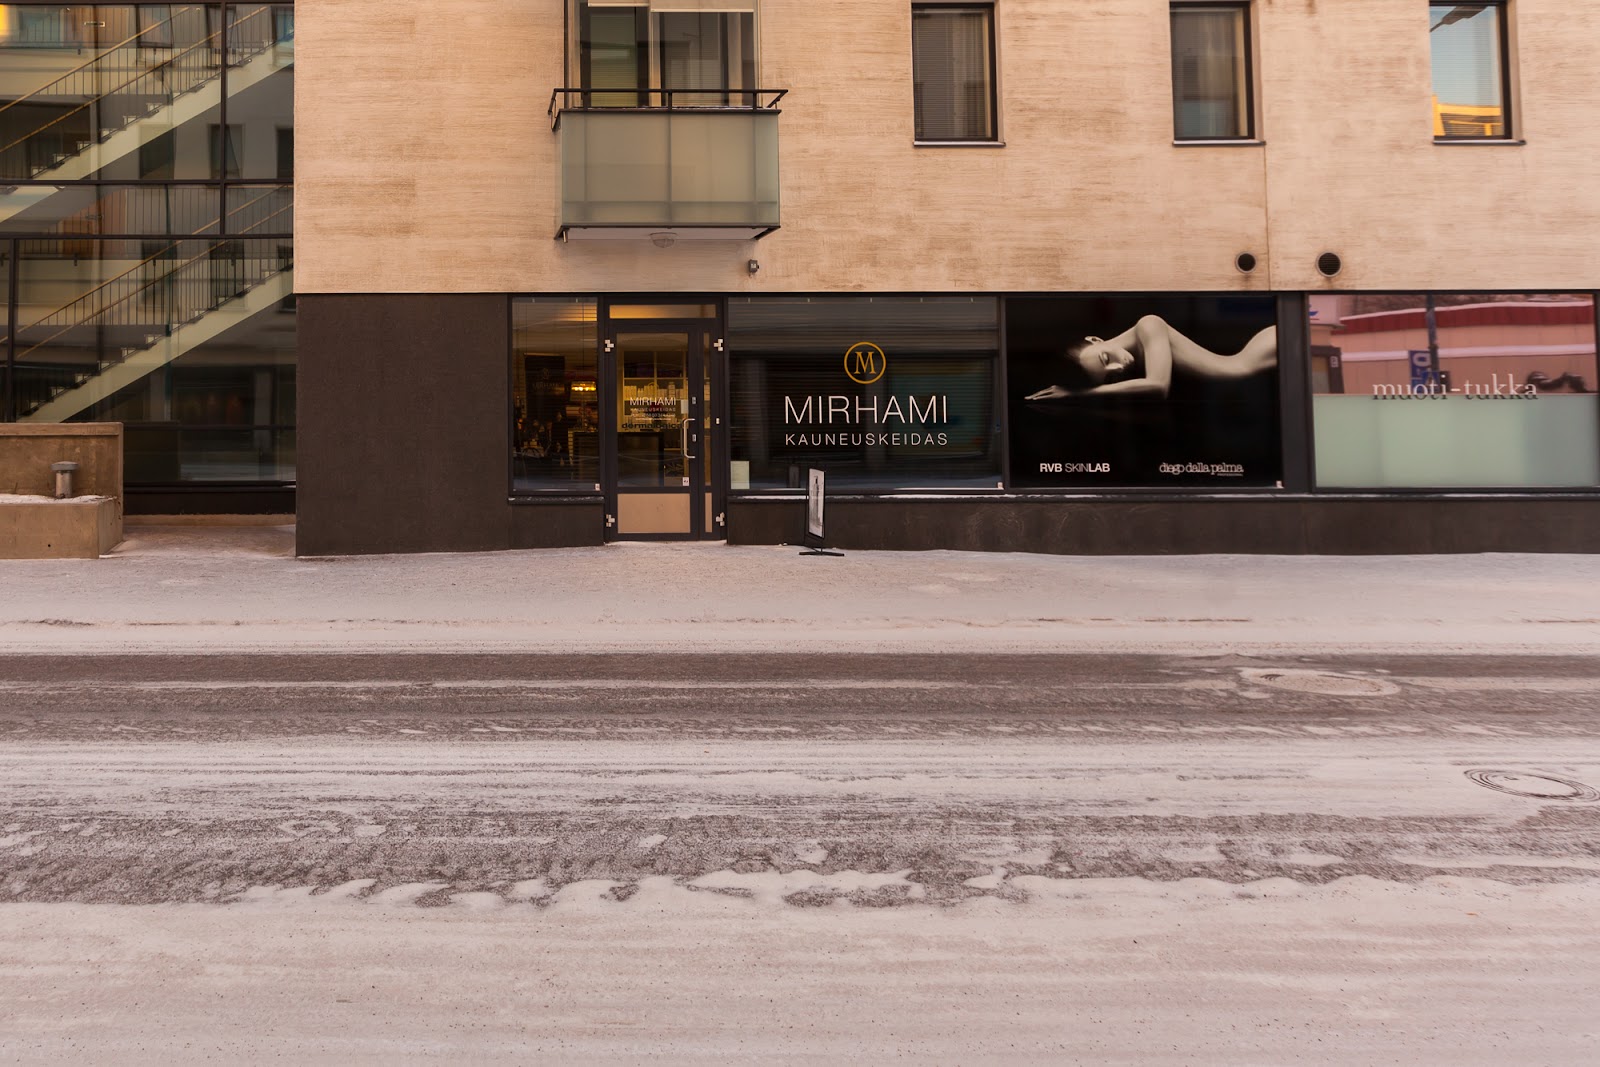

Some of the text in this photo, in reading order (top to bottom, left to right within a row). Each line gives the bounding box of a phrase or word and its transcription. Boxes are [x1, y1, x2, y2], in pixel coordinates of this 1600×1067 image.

[854, 351, 876, 375] M
[1372, 373, 1539, 400] muoti-tukka
[629, 397, 676, 406] MIRHAMI
[784, 395, 948, 424] MIRHAMI
[785, 433, 948, 446] KAUNEUSKEIDAS
[1039, 463, 1110, 473] RVB SKINLAB
[1159, 462, 1244, 475] diego dalla palma
